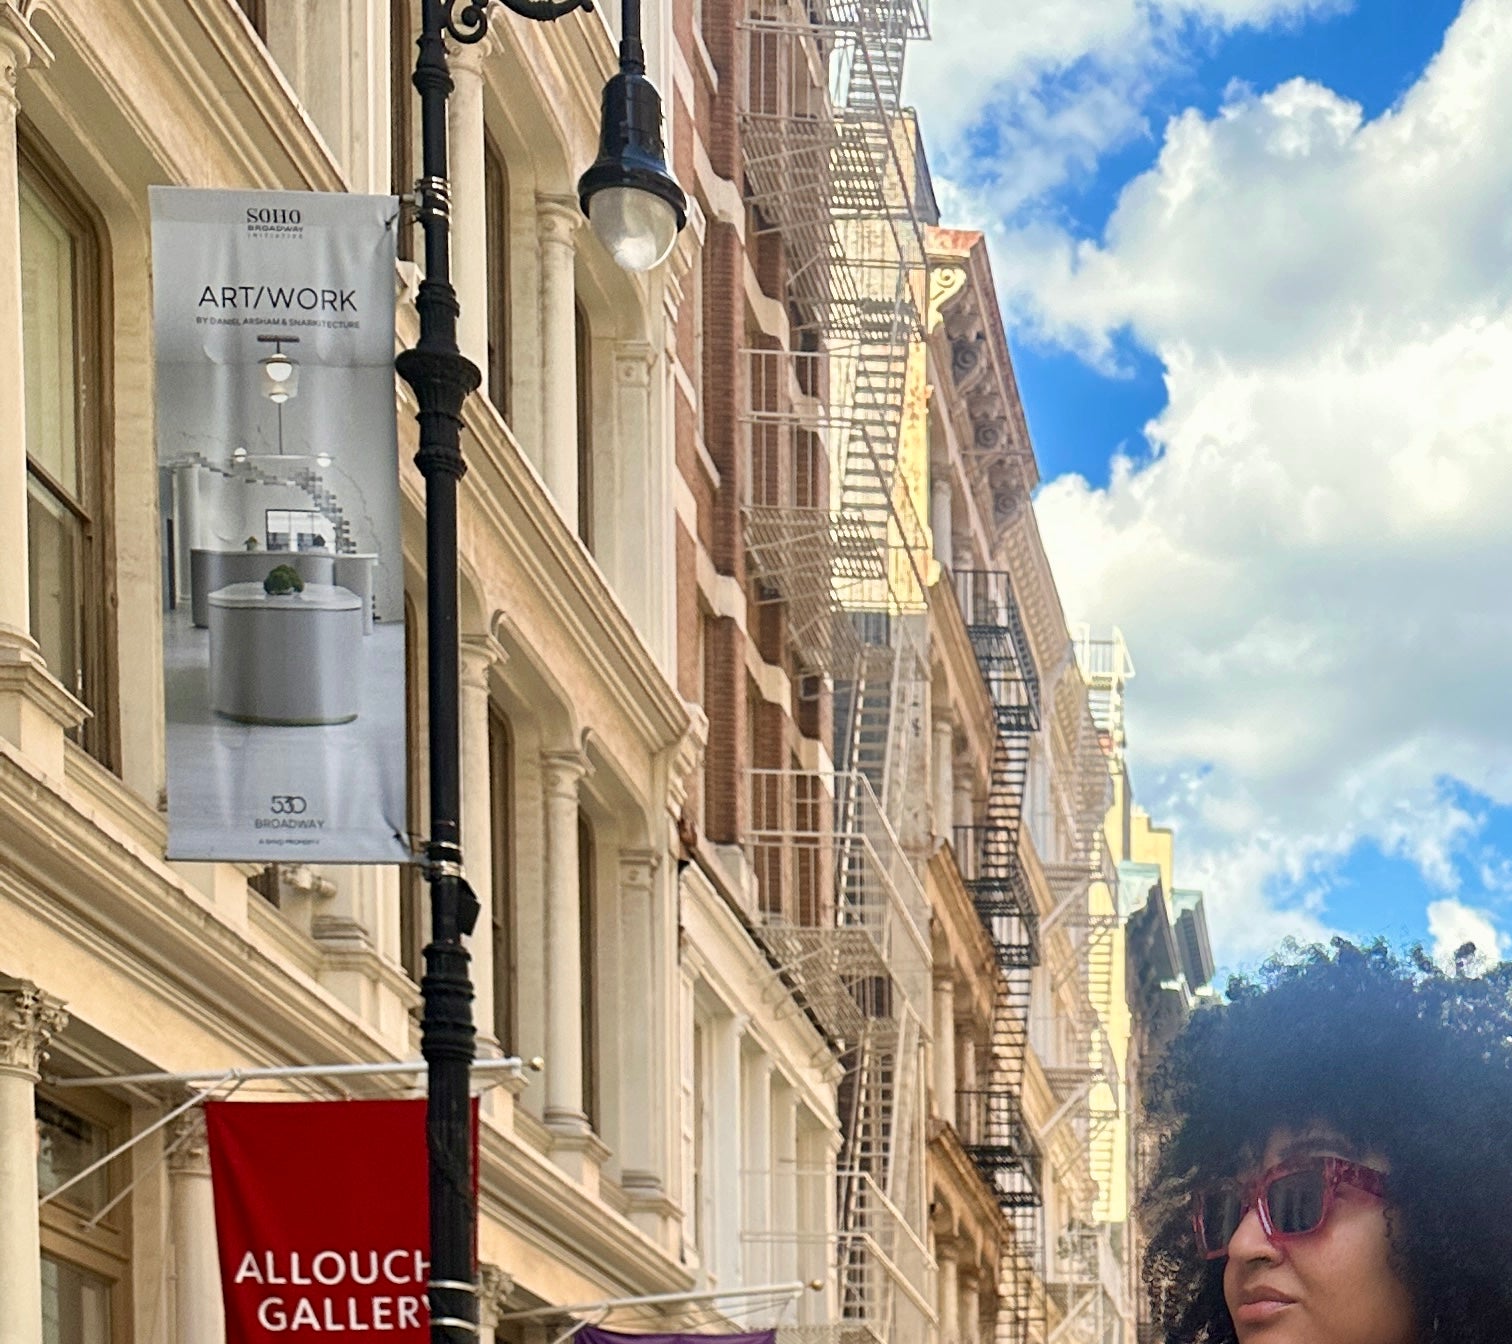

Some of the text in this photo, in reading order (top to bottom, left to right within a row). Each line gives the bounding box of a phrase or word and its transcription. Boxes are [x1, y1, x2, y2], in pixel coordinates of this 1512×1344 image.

[246, 208, 301, 224] SOHO
[198, 285, 358, 312] ART/WORK
[196, 316, 208, 324] BY
[270, 795, 308, 814] 530
[254, 818, 325, 829] BROADWAY
